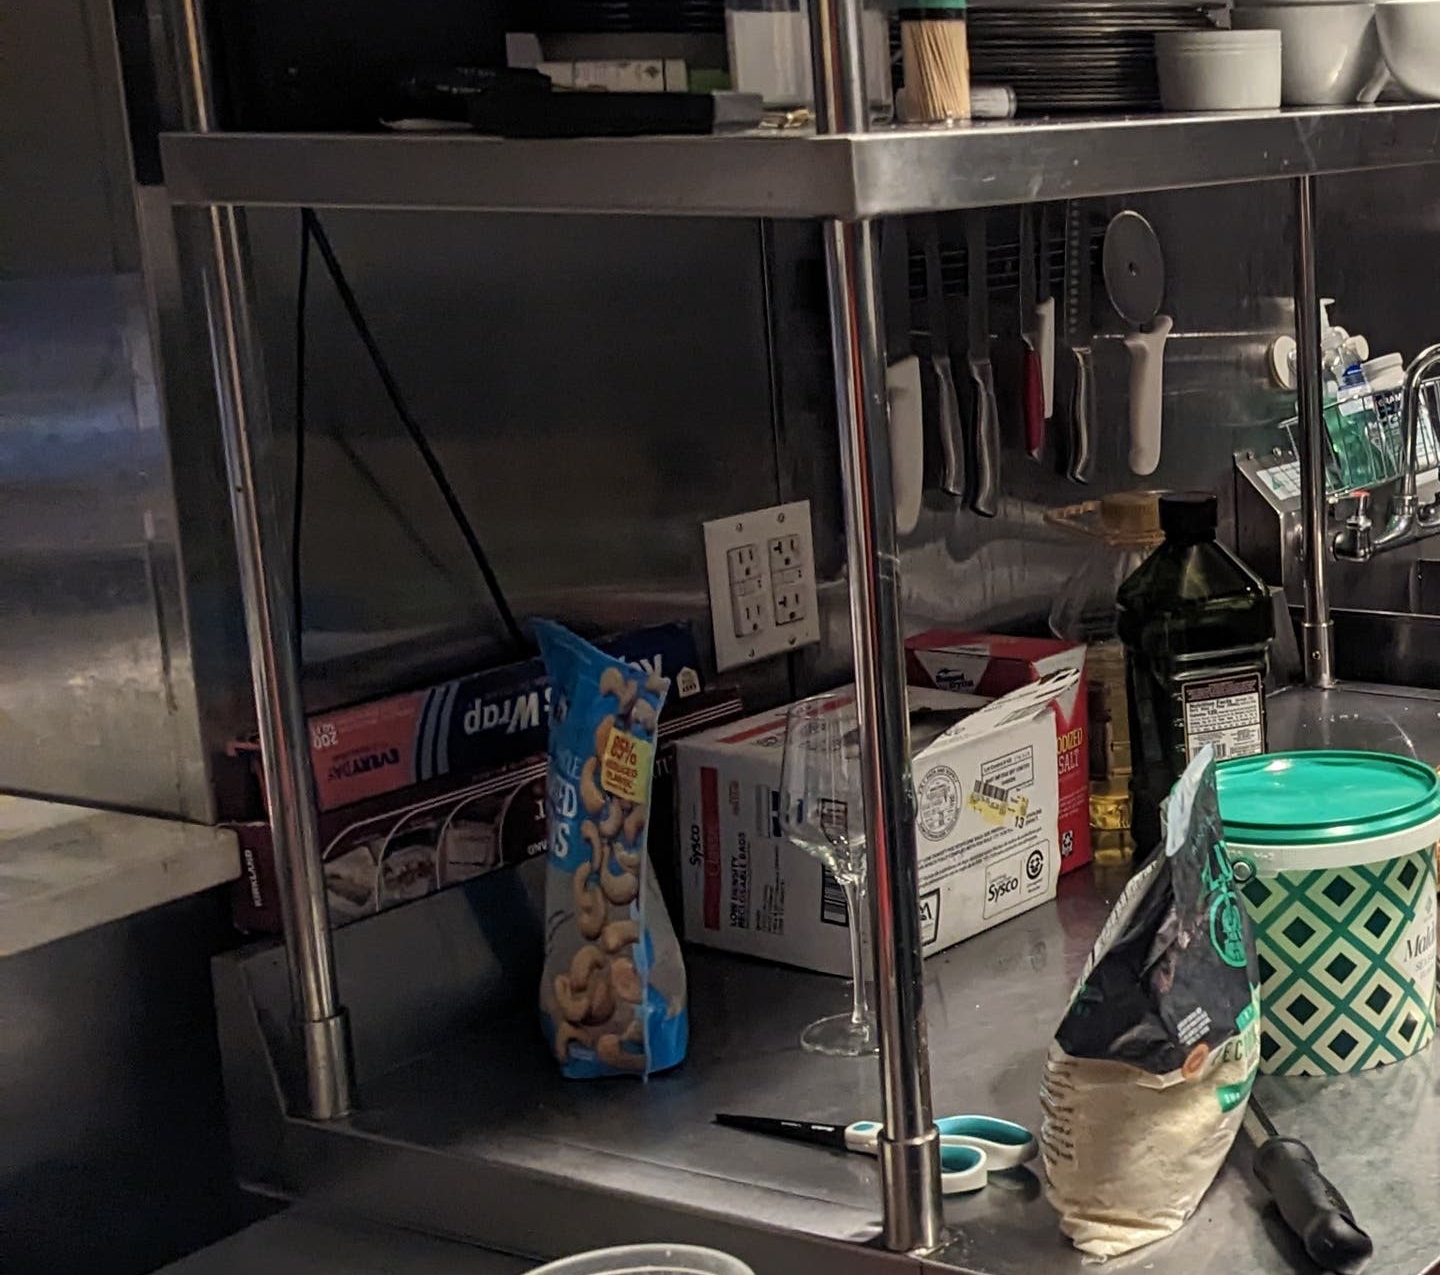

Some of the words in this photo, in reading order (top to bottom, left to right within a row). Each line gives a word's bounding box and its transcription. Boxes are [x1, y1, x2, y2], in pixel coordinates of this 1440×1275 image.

[463, 692, 539, 736] Wrap
[326, 747, 400, 781] EVERYDAY
[1058, 749, 1081, 775] SALT
[689, 823, 704, 868] Sysco
[730, 855, 738, 901] DENSITY
[738, 862, 747, 929] RECLOSABLE
[988, 875, 1018, 903] Sysco
[730, 902, 738, 927] LOW
